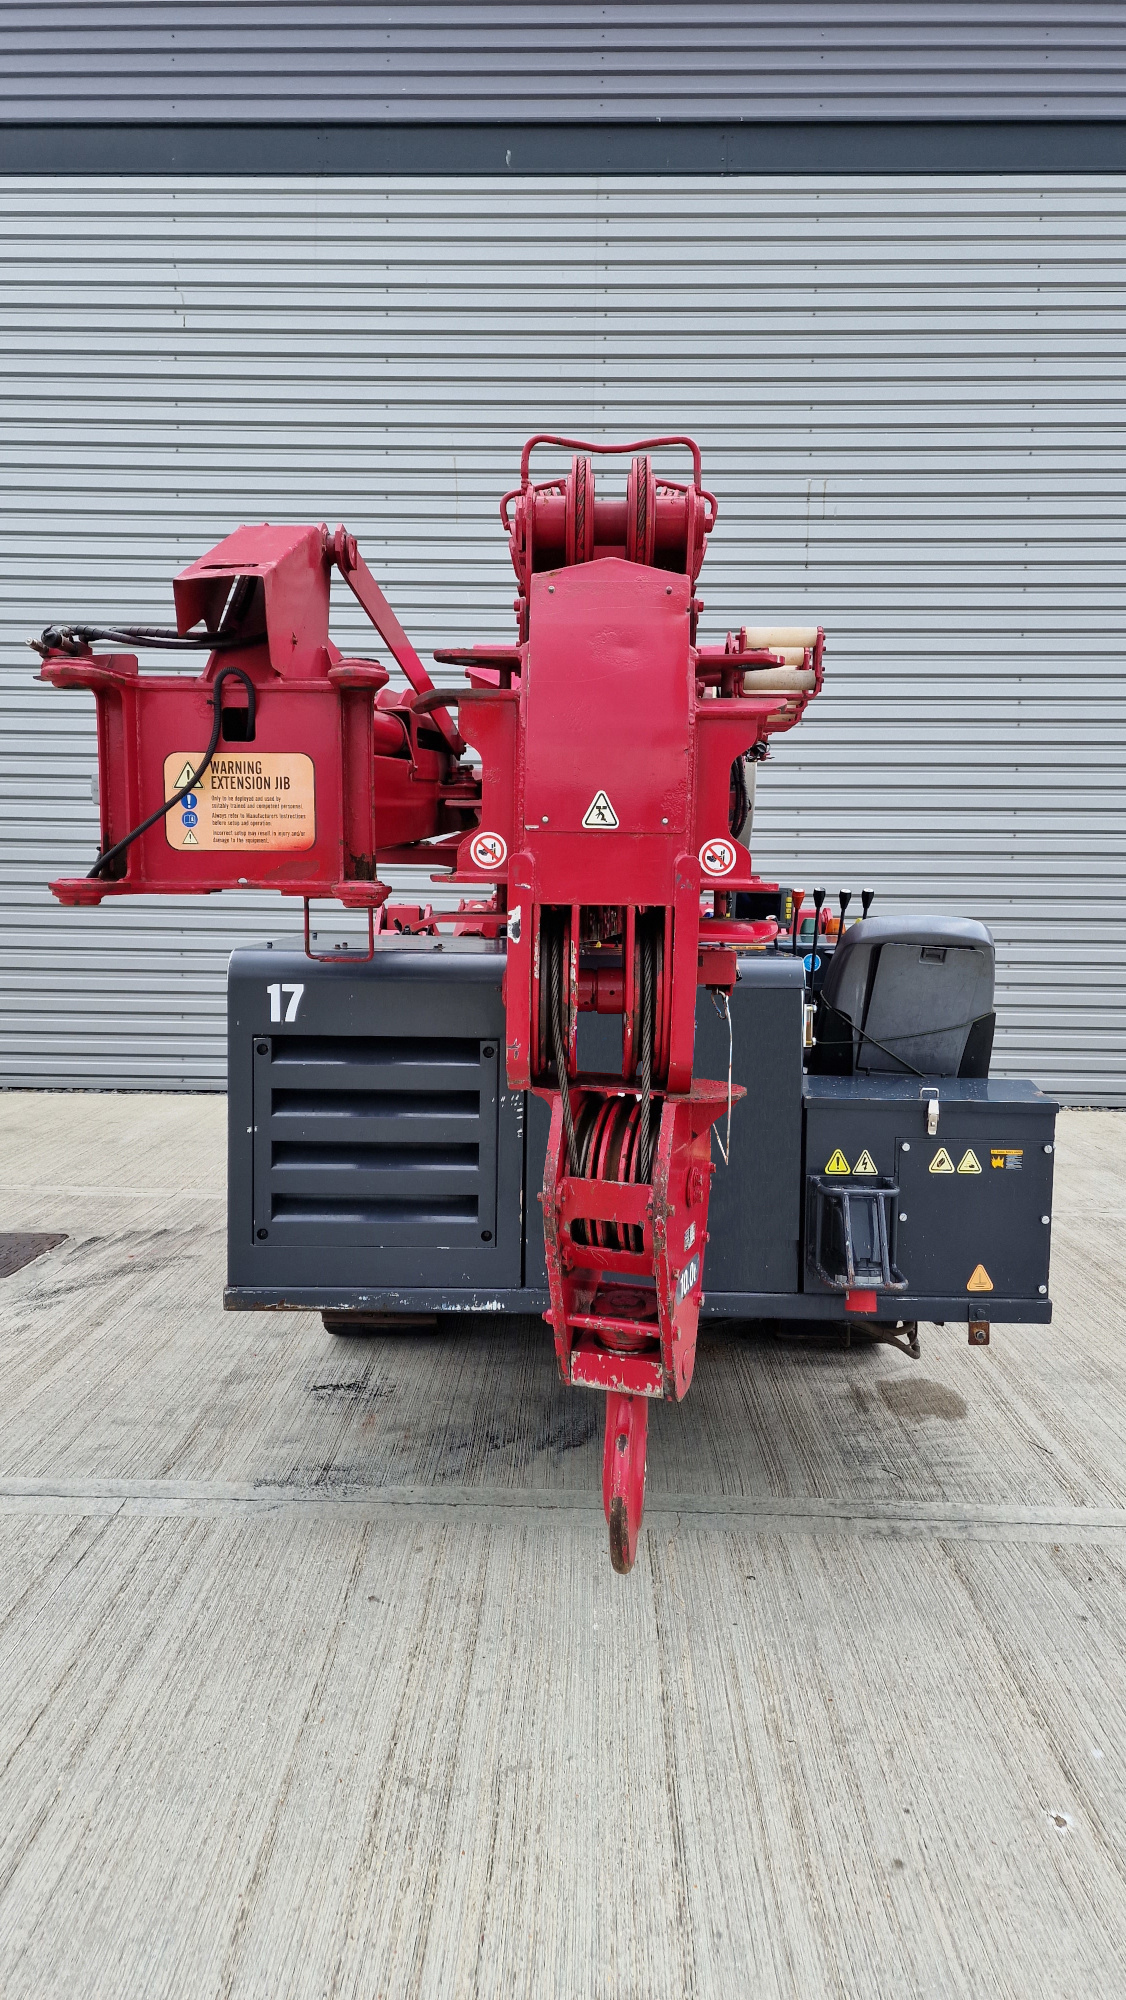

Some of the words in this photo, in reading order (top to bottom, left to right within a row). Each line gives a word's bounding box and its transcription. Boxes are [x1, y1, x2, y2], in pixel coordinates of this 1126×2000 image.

[210, 761, 262, 774] WARNING
[211, 776, 270, 790] EXTENSION
[274, 777, 290, 790] JIB
[267, 984, 304, 1022] 17
